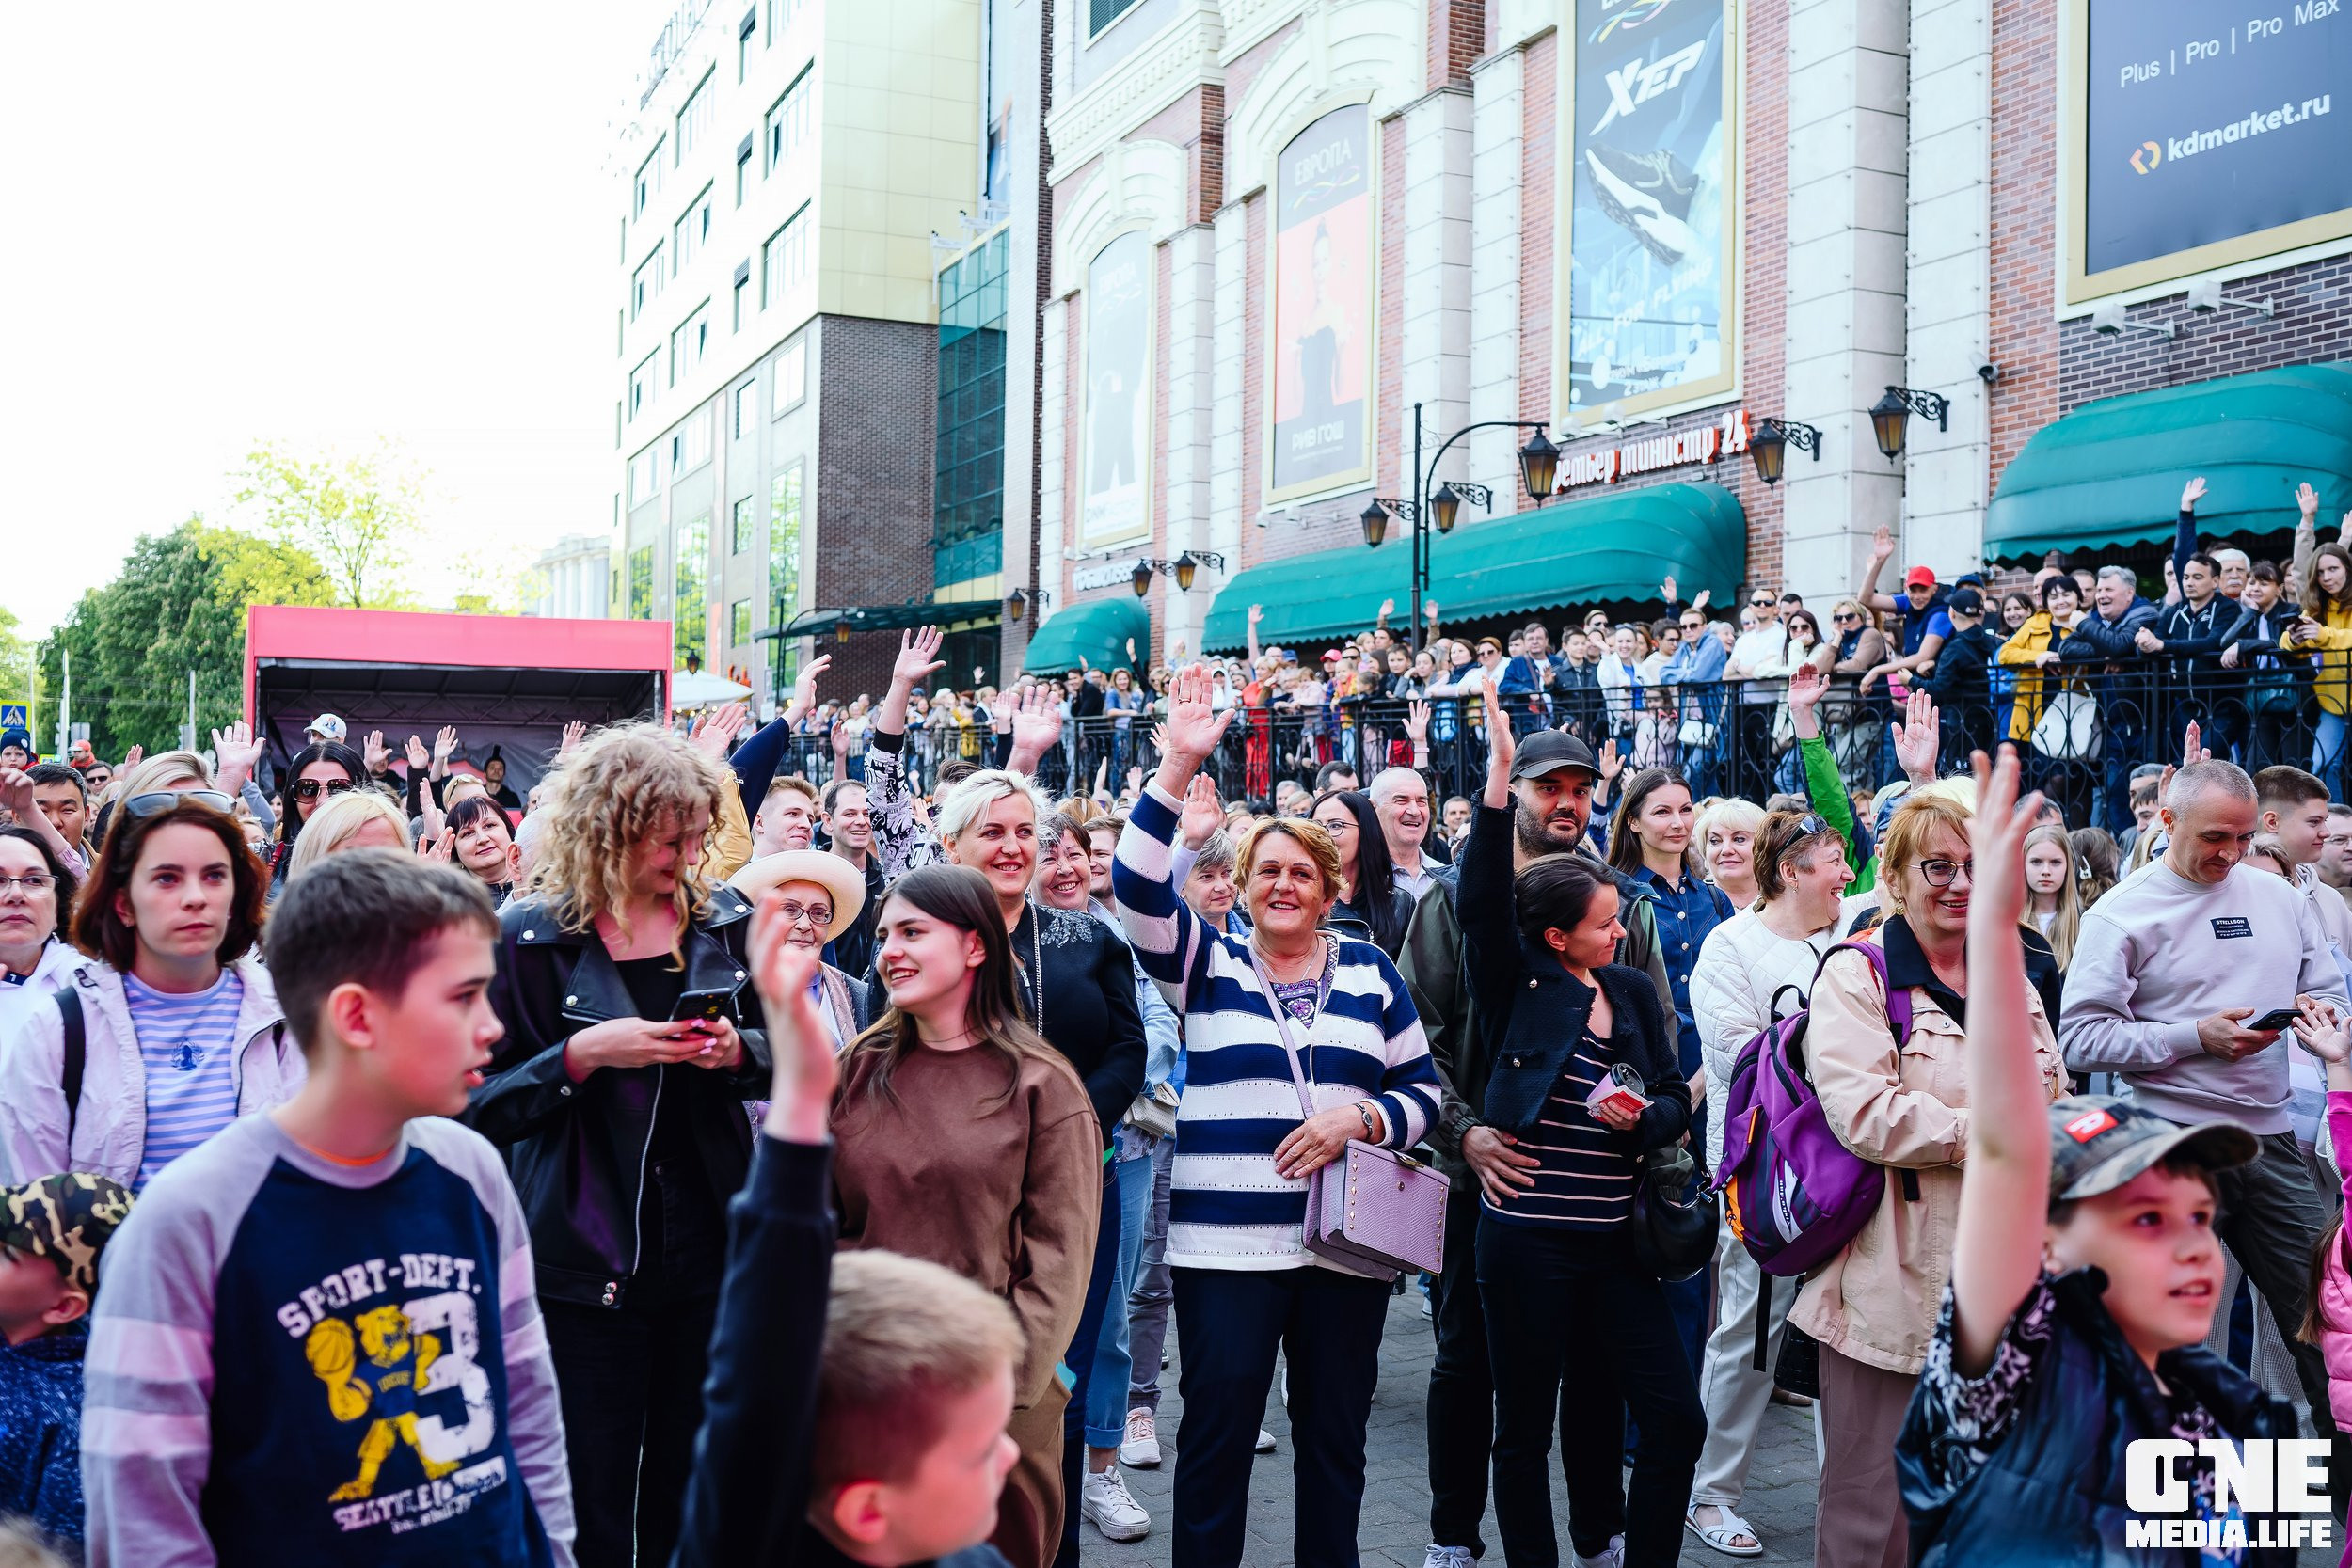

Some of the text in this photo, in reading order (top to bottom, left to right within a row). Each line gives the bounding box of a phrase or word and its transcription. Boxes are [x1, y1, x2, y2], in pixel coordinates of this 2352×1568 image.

[2121, 60, 2160, 88] Plus
[2186, 40, 2219, 64] Pro
[2248, 17, 2282, 42] Pro
[2295, 0, 2340, 26] Max
[1588, 40, 1706, 136] XTEP
[1295, 137, 1352, 187] ЕВРОПА
[2168, 94, 2330, 162] kdmarket.ru
[1721, 408, 1751, 455] 24
